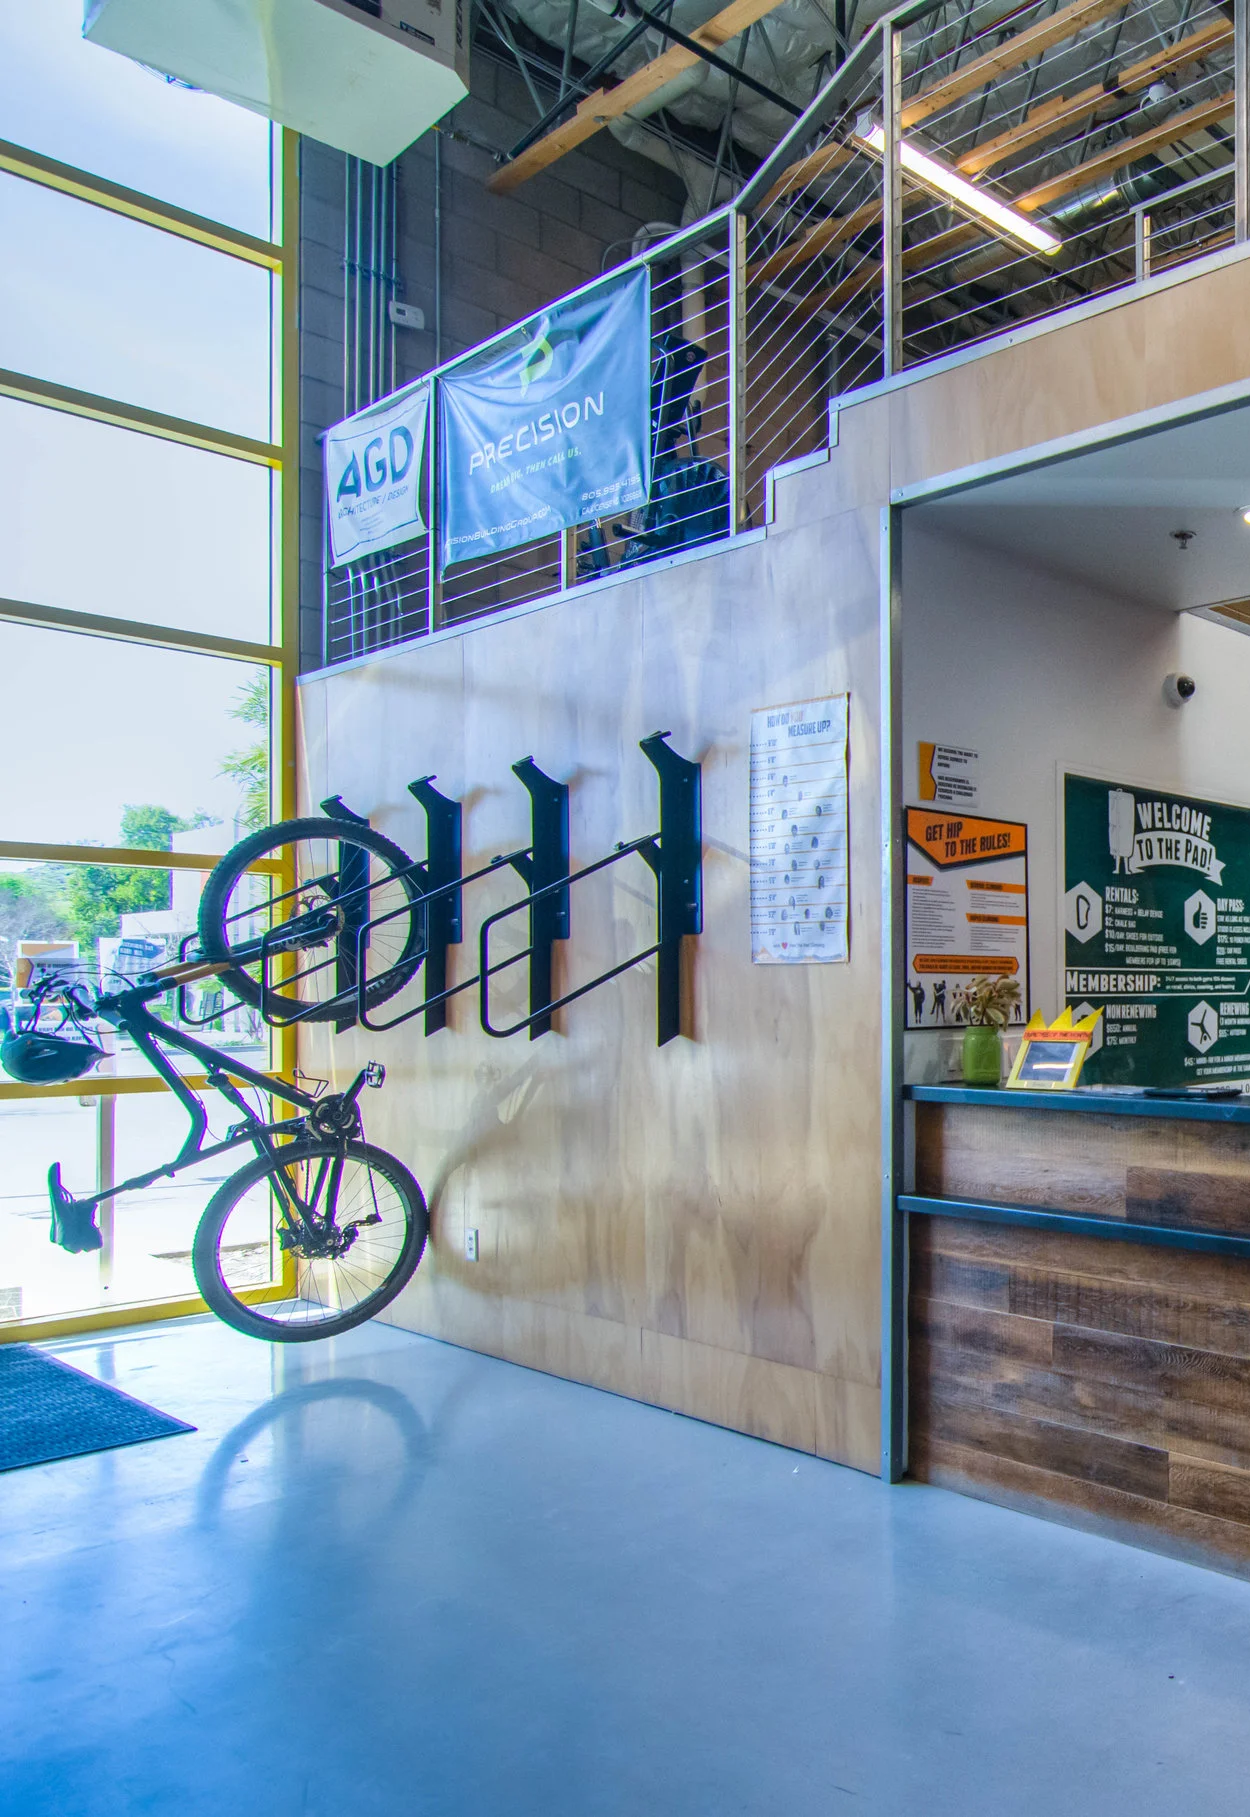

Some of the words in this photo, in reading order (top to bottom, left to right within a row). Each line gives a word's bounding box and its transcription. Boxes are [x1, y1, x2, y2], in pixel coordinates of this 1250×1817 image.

[469, 391, 604, 475] PRECISION
[336, 425, 414, 503] AGD
[526, 459, 546, 474] THEN
[547, 451, 565, 466] CALL
[767, 714, 780, 728] HOW
[780, 712, 790, 726] DO
[787, 721, 817, 738] MEASURE
[816, 719, 831, 733] UP?
[925, 824, 944, 842] GET
[946, 821, 963, 839] HIP
[1136, 801, 1212, 841] WELCOME
[944, 840, 957, 858] TO
[960, 837, 977, 855] THE
[980, 832, 1011, 852] RULES!
[1136, 838, 1154, 861] TO
[1156, 838, 1180, 861] THE
[1184, 838, 1213, 871] PAD!
[1105, 886, 1139, 904] RENTALS:
[1066, 970, 1161, 992] MEMBERSHIP:
[1220, 1002, 1249, 1015] RENEWING
